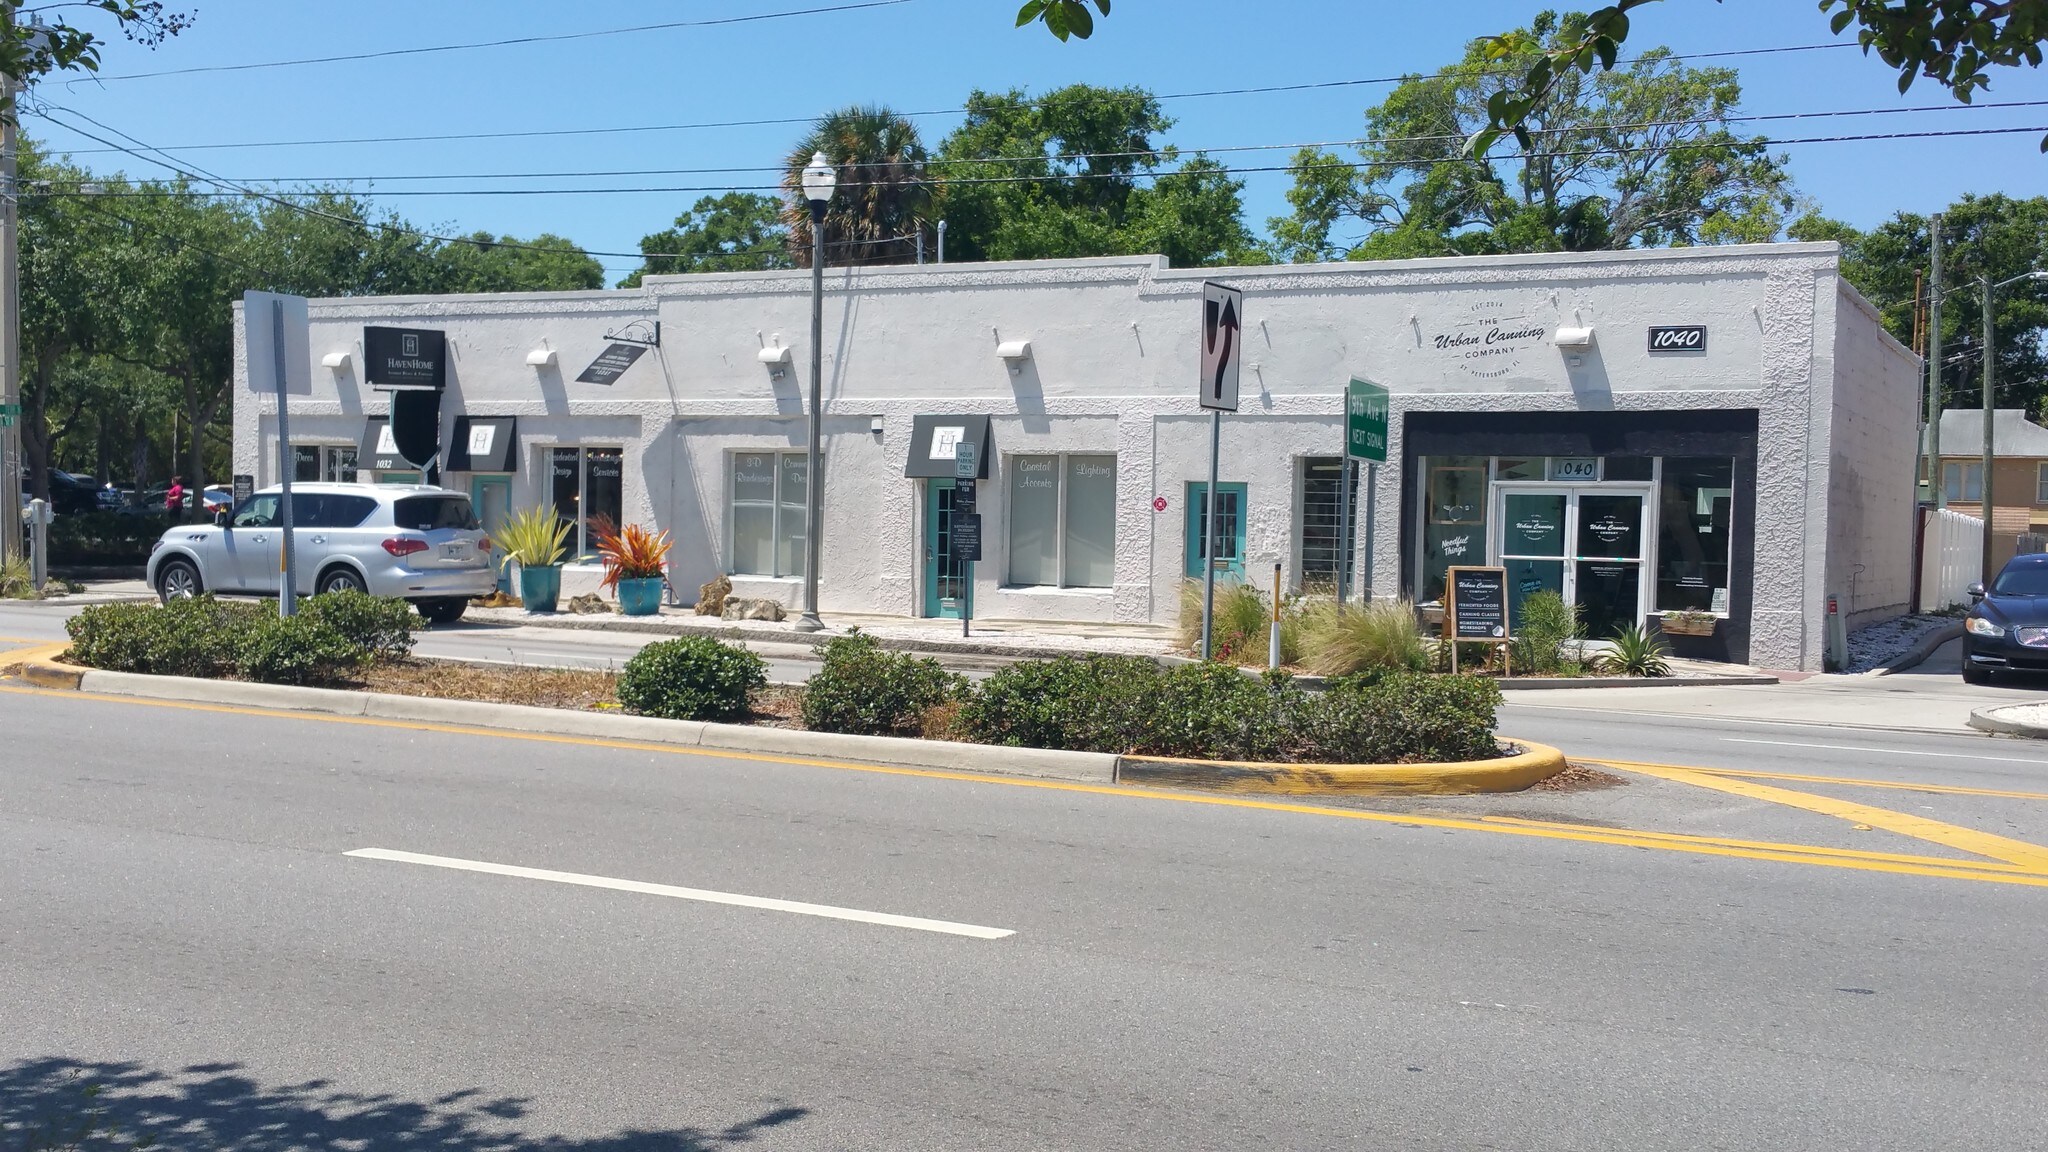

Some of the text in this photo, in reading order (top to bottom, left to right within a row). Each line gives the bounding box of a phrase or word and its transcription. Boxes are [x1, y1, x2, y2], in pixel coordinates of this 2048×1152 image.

[1479, 318, 1498, 326] THE
[1434, 327, 1545, 349] Urban Canning
[1654, 330, 1700, 347] 1040
[1465, 346, 1515, 359] COMPANY
[1351, 394, 1387, 423] 9th Ave N
[1352, 428, 1384, 450] NEXT SIGNAL
[376, 460, 392, 469] 1032
[1020, 459, 1051, 472] Coastal
[1076, 463, 1110, 478] Lighting
[1019, 476, 1052, 488] Accents
[1441, 535, 1469, 549] Needful
[1444, 546, 1467, 556] Things
[1458, 581, 1499, 590] Urban Canning
